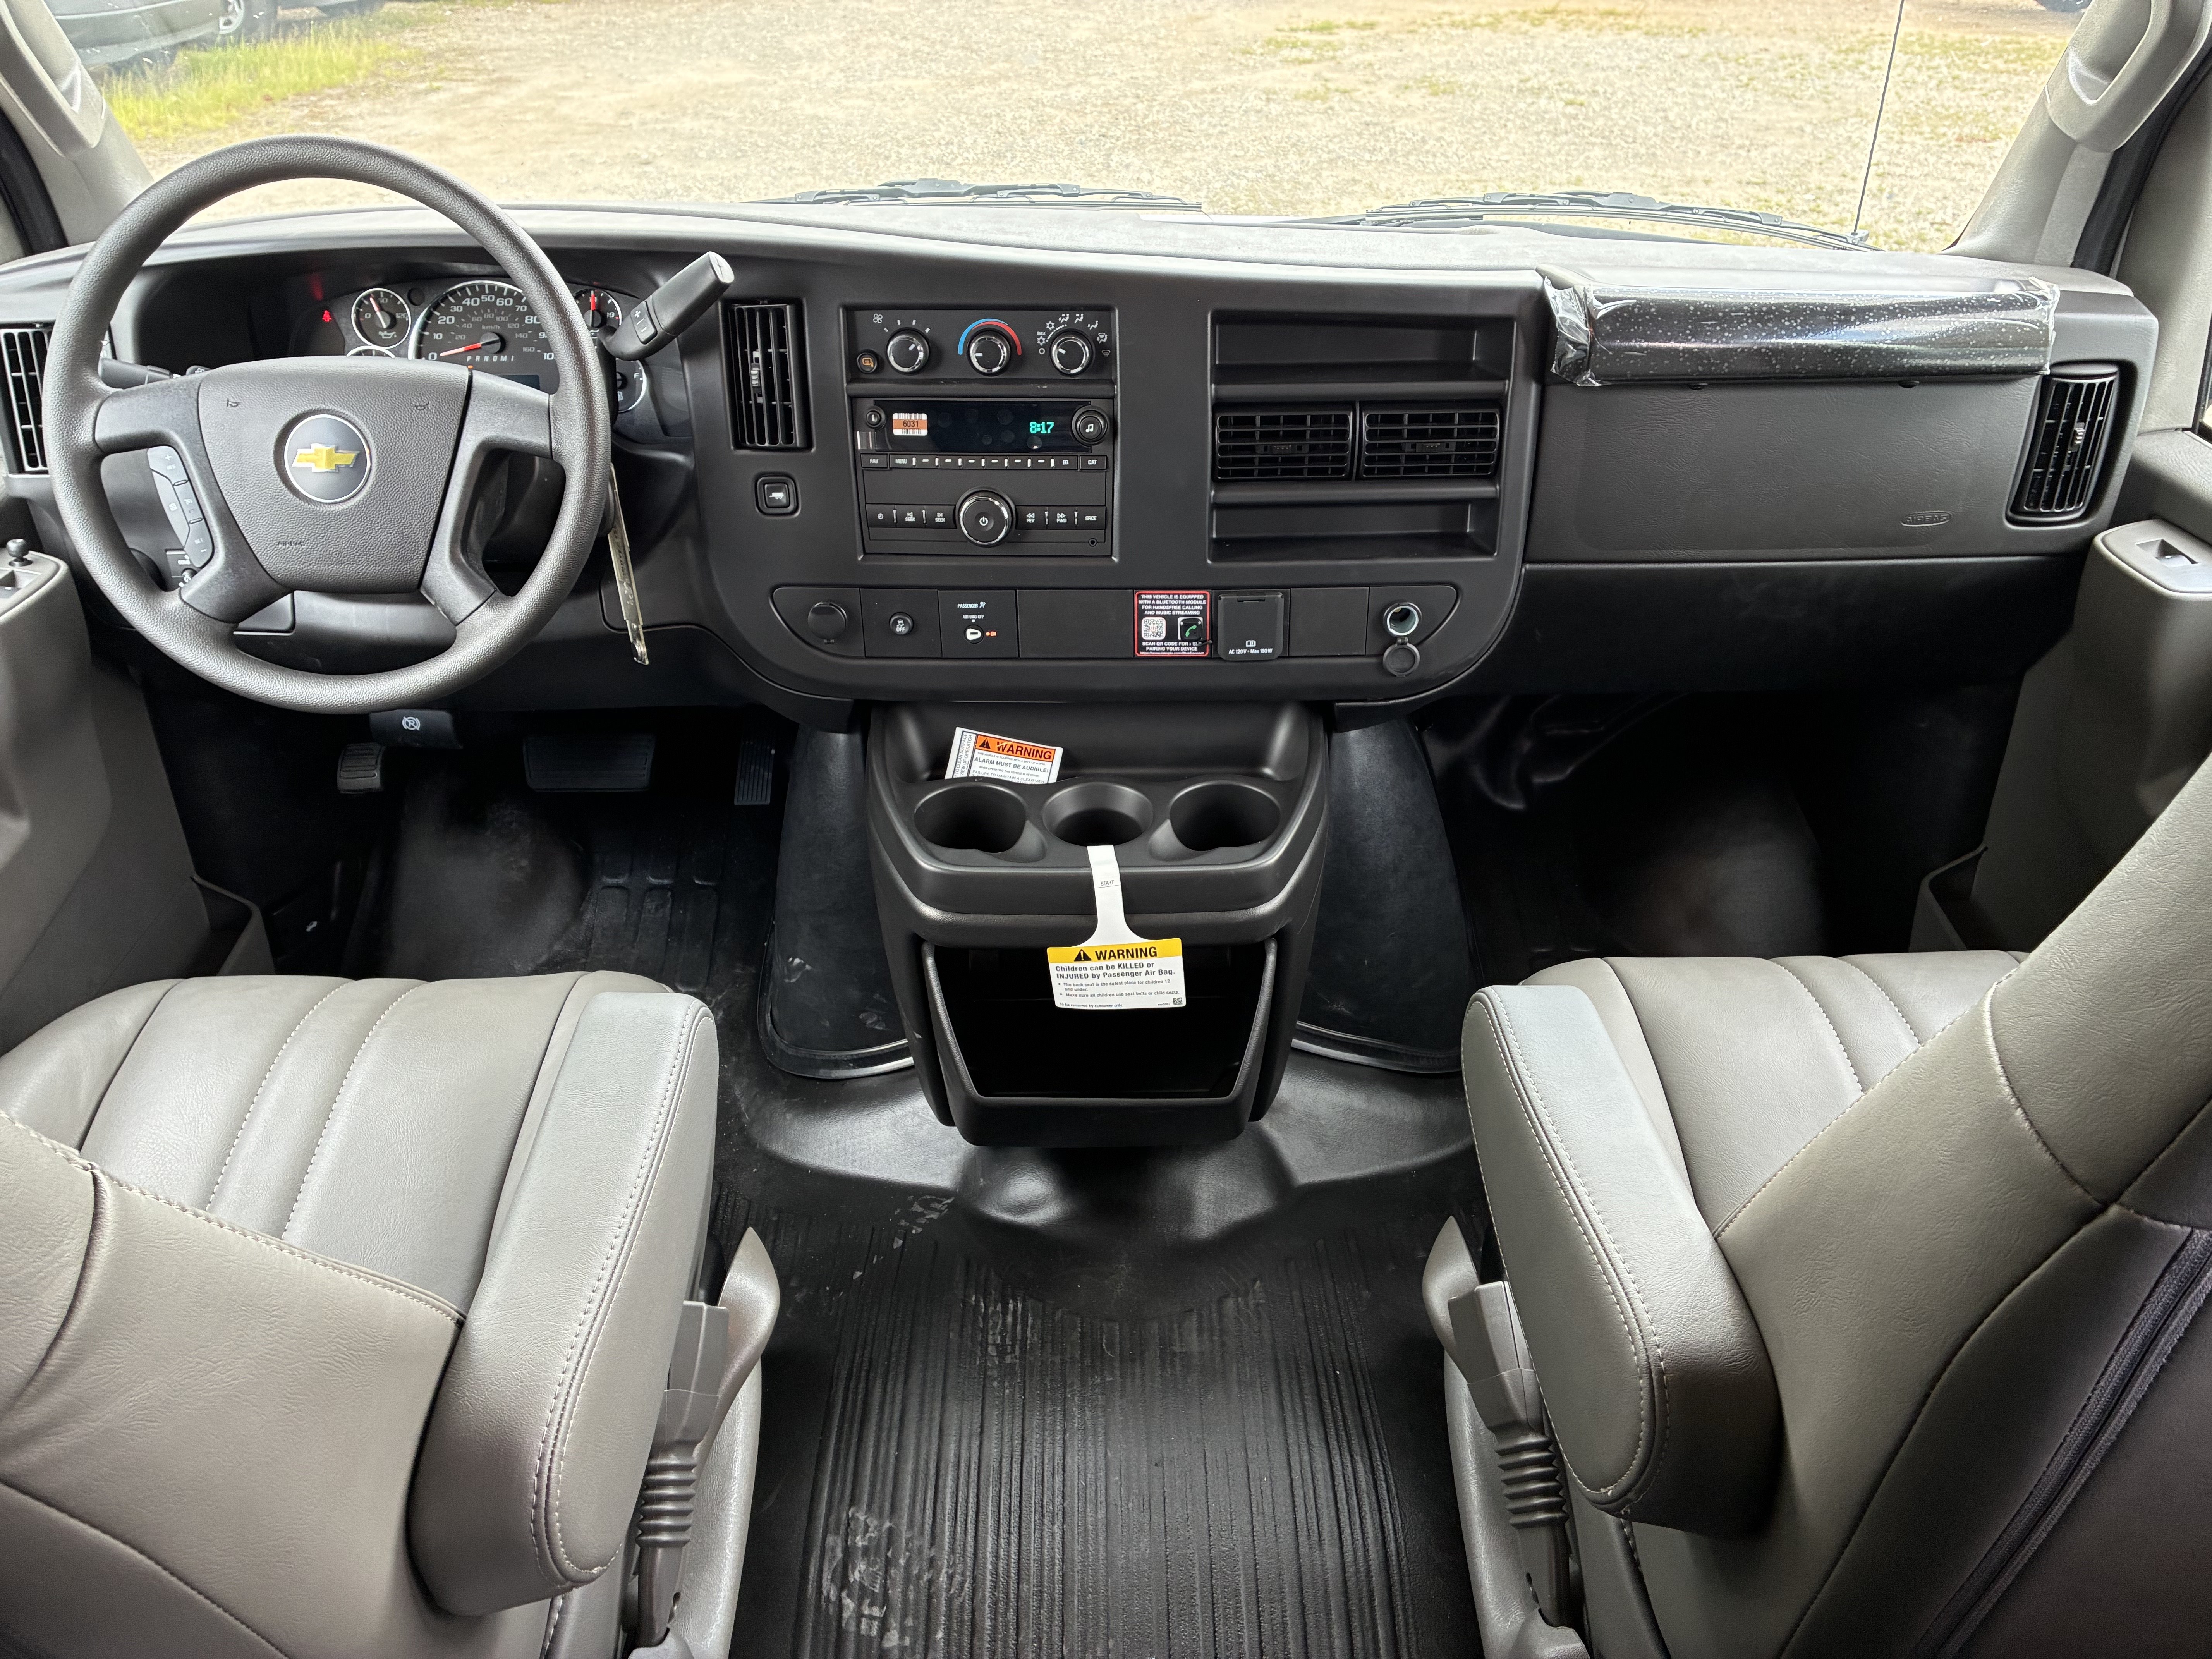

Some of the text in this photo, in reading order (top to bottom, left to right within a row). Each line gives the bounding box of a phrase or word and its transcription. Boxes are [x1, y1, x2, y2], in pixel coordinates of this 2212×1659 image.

[462, 297, 480, 306] 40
[496, 297, 514, 306] 60
[438, 316, 455, 325] 20
[428, 352, 438, 360] 0
[1029, 421, 1054, 433] 8:17
[964, 735, 972, 759] OPERATOR
[996, 741, 1053, 760] WARNING
[1095, 946, 1157, 960] WARNING
